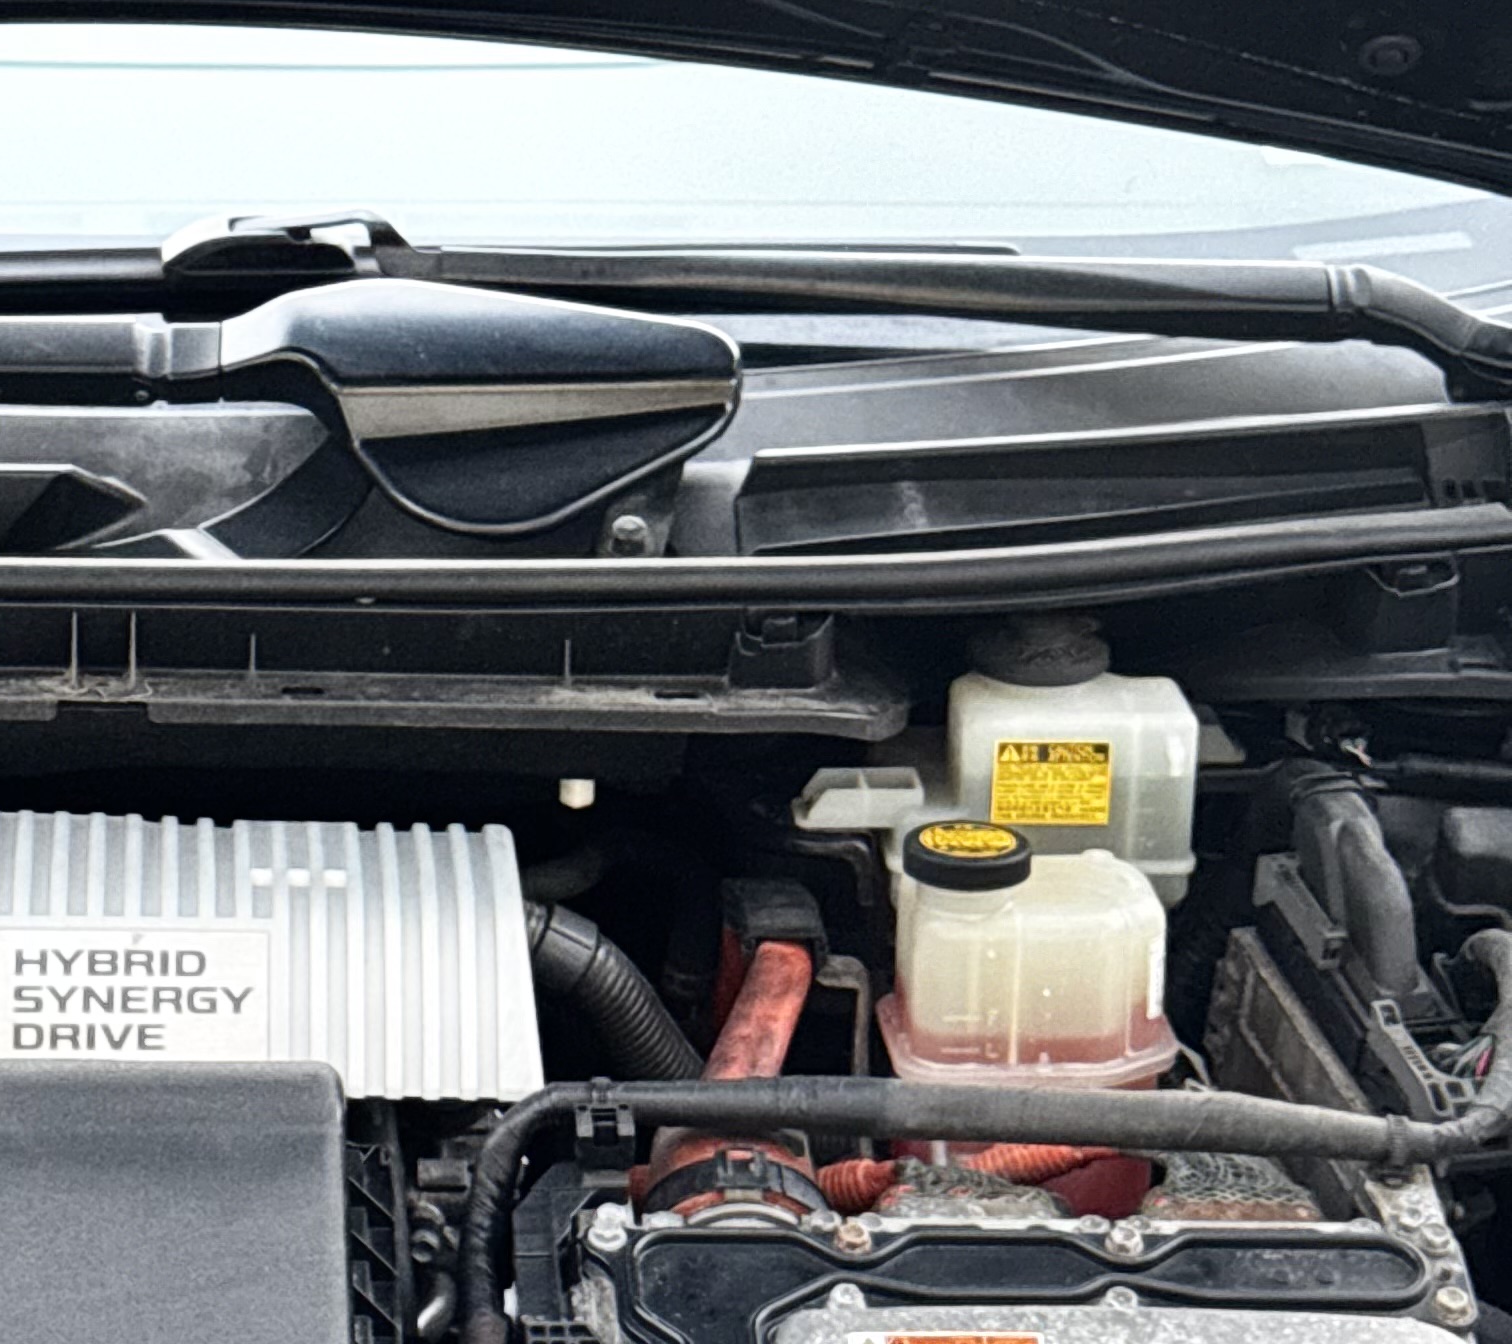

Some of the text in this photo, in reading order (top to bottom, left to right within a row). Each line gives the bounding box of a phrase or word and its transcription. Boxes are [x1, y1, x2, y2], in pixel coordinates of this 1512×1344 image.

[14, 949, 207, 977] HYBRID
[12, 986, 255, 1013] SYNERGY
[12, 1023, 166, 1051] DRIVE
